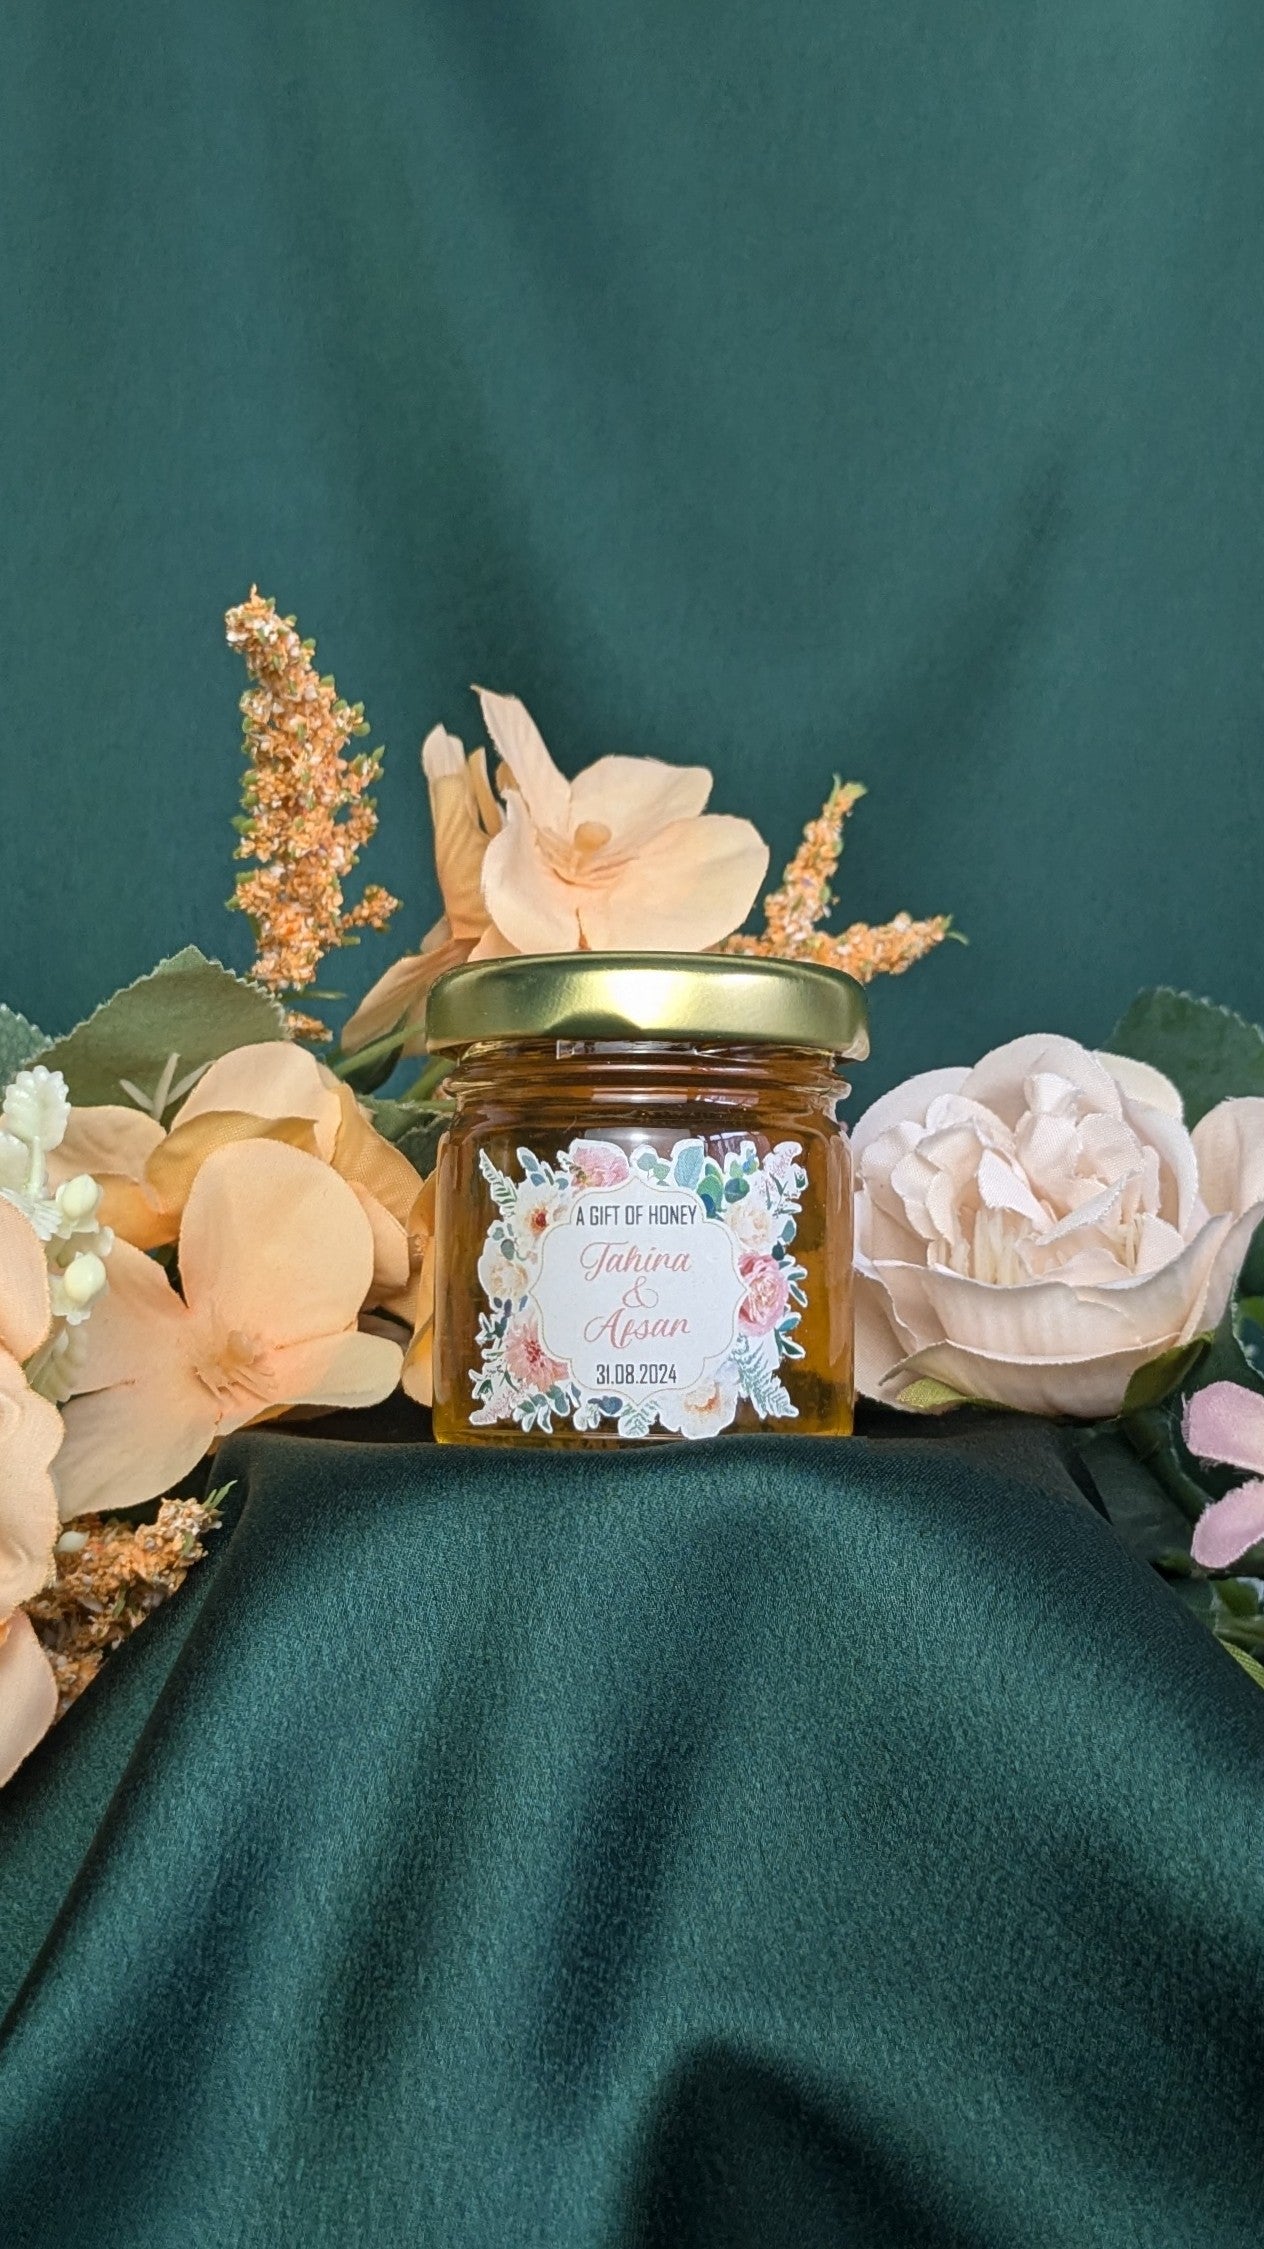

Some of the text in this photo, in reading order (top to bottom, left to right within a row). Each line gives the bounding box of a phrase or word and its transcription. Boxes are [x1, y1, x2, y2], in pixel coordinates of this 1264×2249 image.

[576, 1205, 697, 1225] A GIFT OF HONEY
[580, 1241, 691, 1281] Tahira
[622, 1276, 659, 1308] &
[596, 1364, 677, 1385] 31.08.2024
